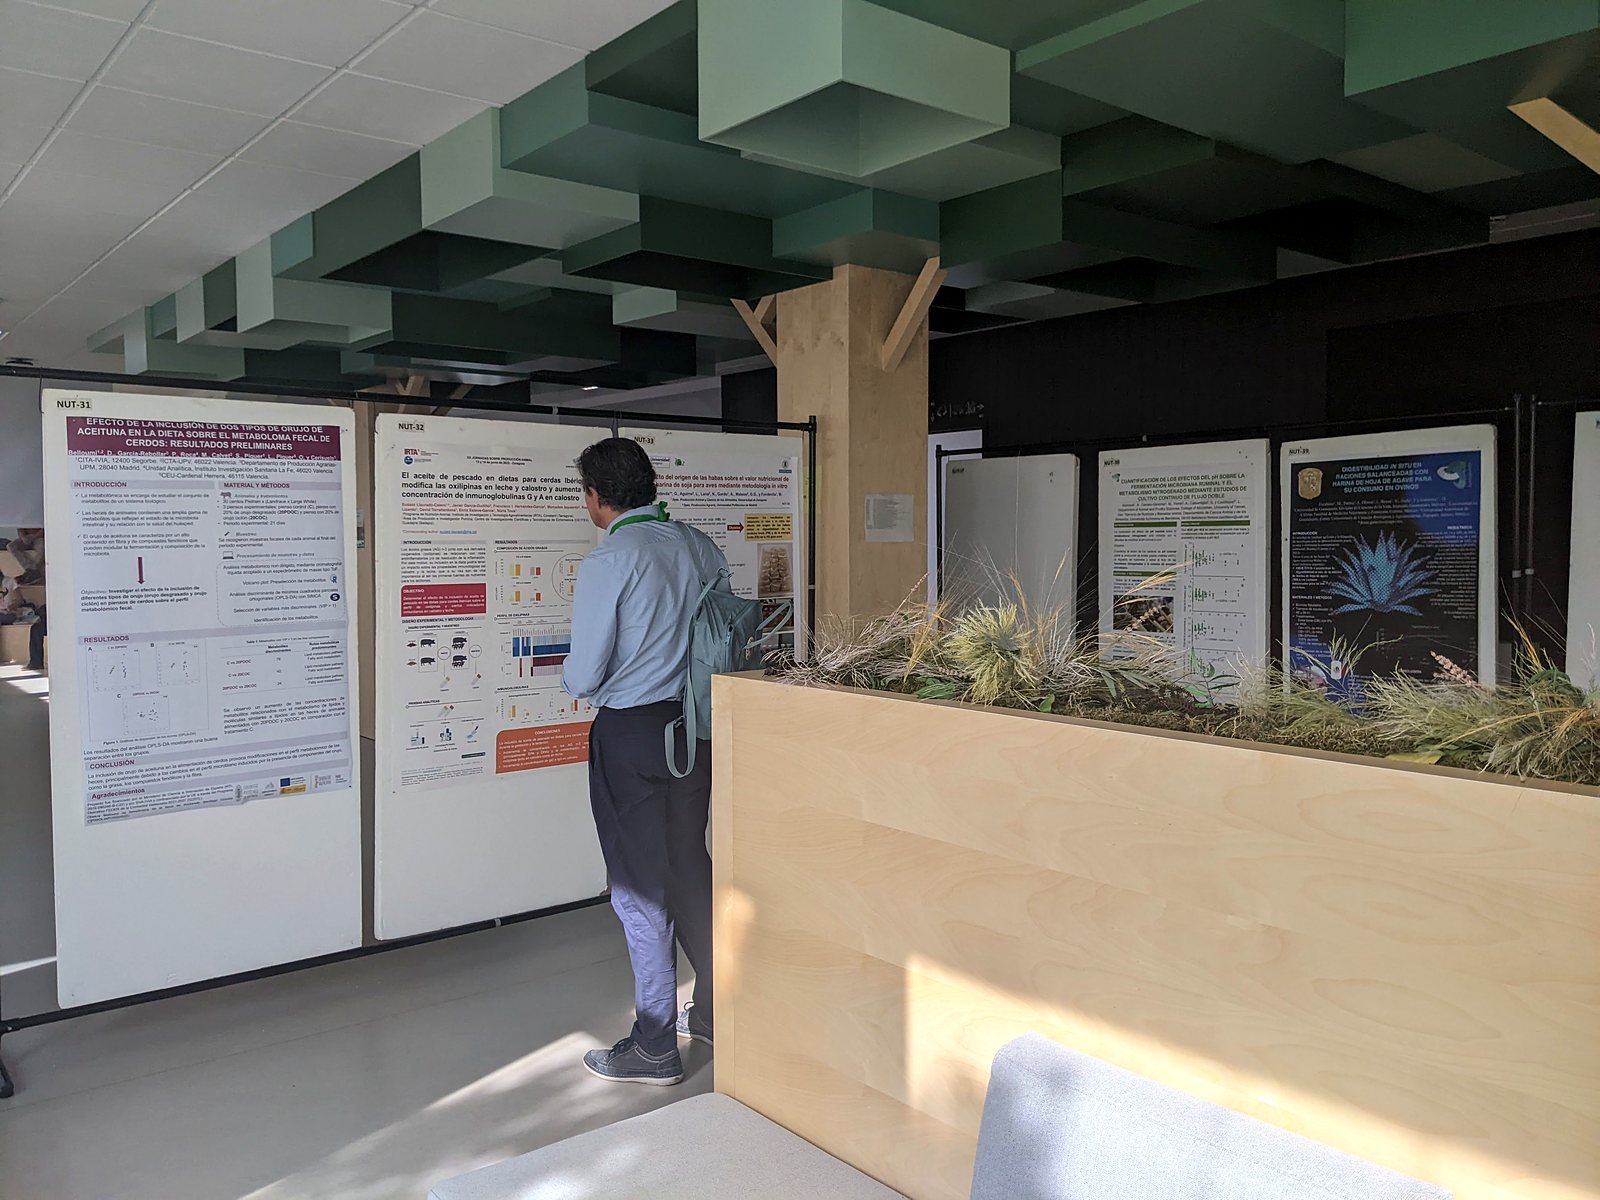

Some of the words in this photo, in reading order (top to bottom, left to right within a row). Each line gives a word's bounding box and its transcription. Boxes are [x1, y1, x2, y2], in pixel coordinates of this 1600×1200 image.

[87, 418, 124, 427] EFECTO
[156, 421, 204, 430] INCLUSIÓN
[78, 428, 126, 436] ACEITUNA
[232, 433, 291, 442] METABOLOMA
[170, 441, 229, 449] RESULTADOS
[231, 442, 292, 451] PRELIMINARES
[465, 493, 525, 501] inmunoglobulinas
[90, 759, 135, 770] CONCLUSIÓN
[92, 788, 145, 800] Agradecimientos
